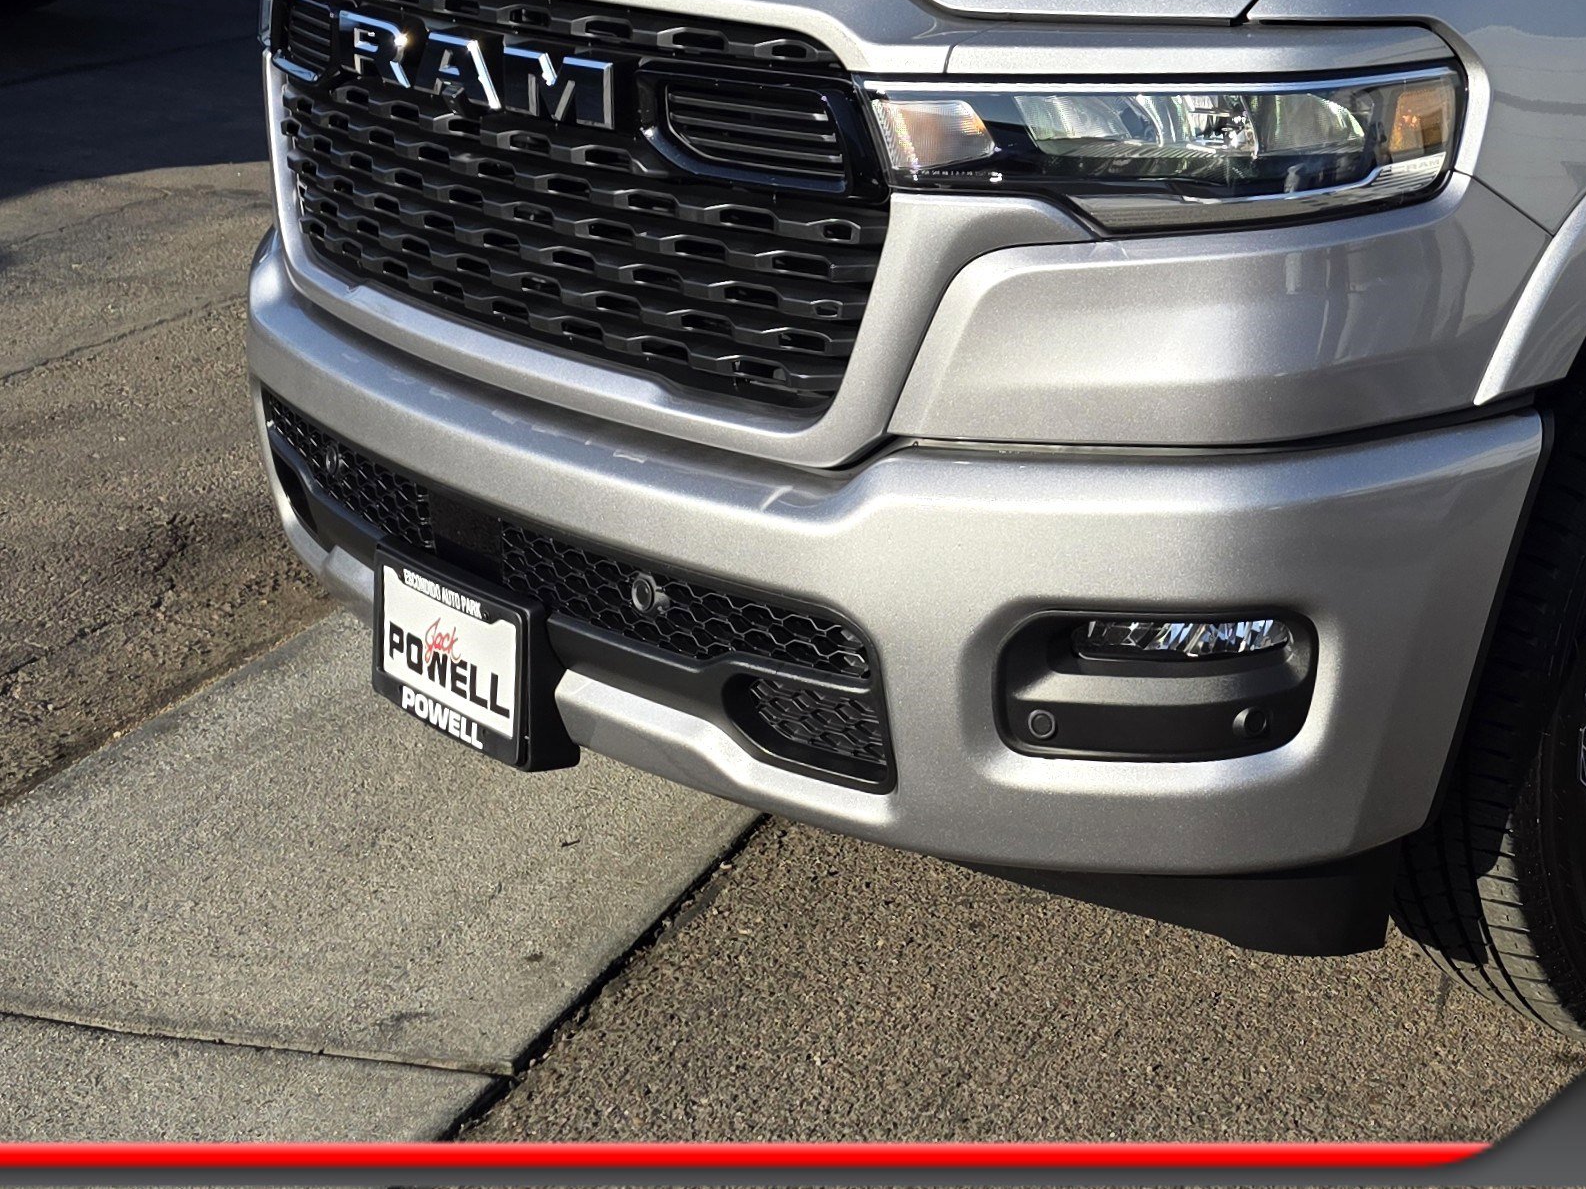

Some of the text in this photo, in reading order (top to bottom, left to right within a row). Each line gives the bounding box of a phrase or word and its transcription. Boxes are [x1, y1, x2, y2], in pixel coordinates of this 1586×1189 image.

[337, 9, 615, 131] RAM
[442, 586, 461, 610] AUTO
[460, 595, 483, 620] PARK
[388, 620, 511, 719] POWELL
[425, 617, 461, 665] Jack
[401, 685, 484, 750] POWELL
